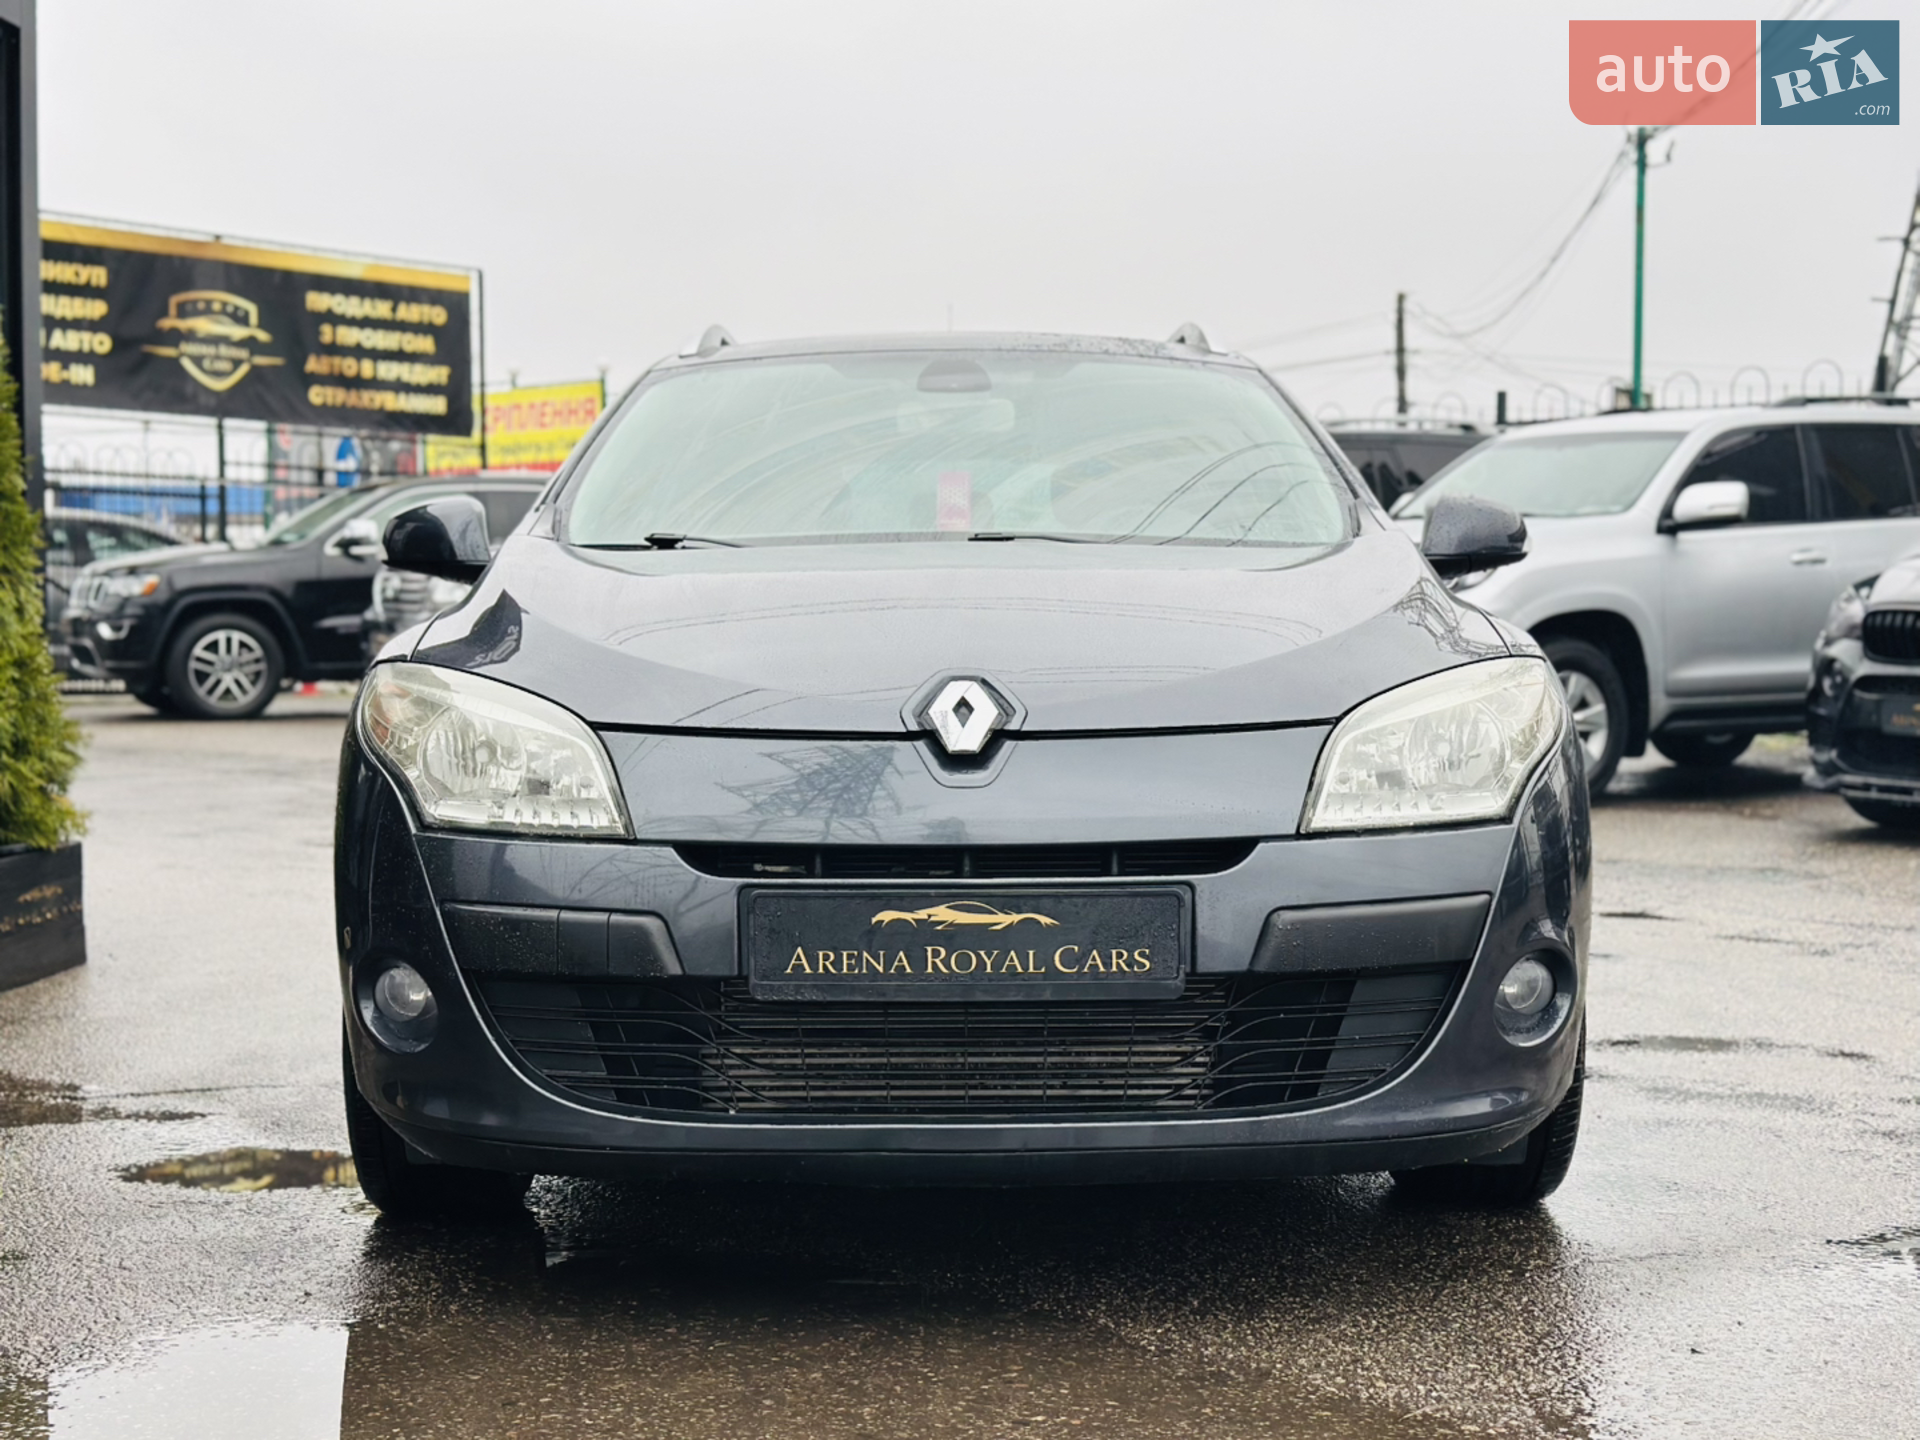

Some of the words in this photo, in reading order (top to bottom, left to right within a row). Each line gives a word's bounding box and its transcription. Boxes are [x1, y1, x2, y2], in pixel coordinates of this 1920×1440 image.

[395, 301, 448, 326] АВТО
[49, 327, 113, 355] АВТО
[304, 353, 359, 378] АВТО
[360, 357, 375, 380] В
[784, 946, 913, 974] ARENA
[924, 945, 1046, 974] ROYAL
[1053, 945, 1151, 973] CARS
